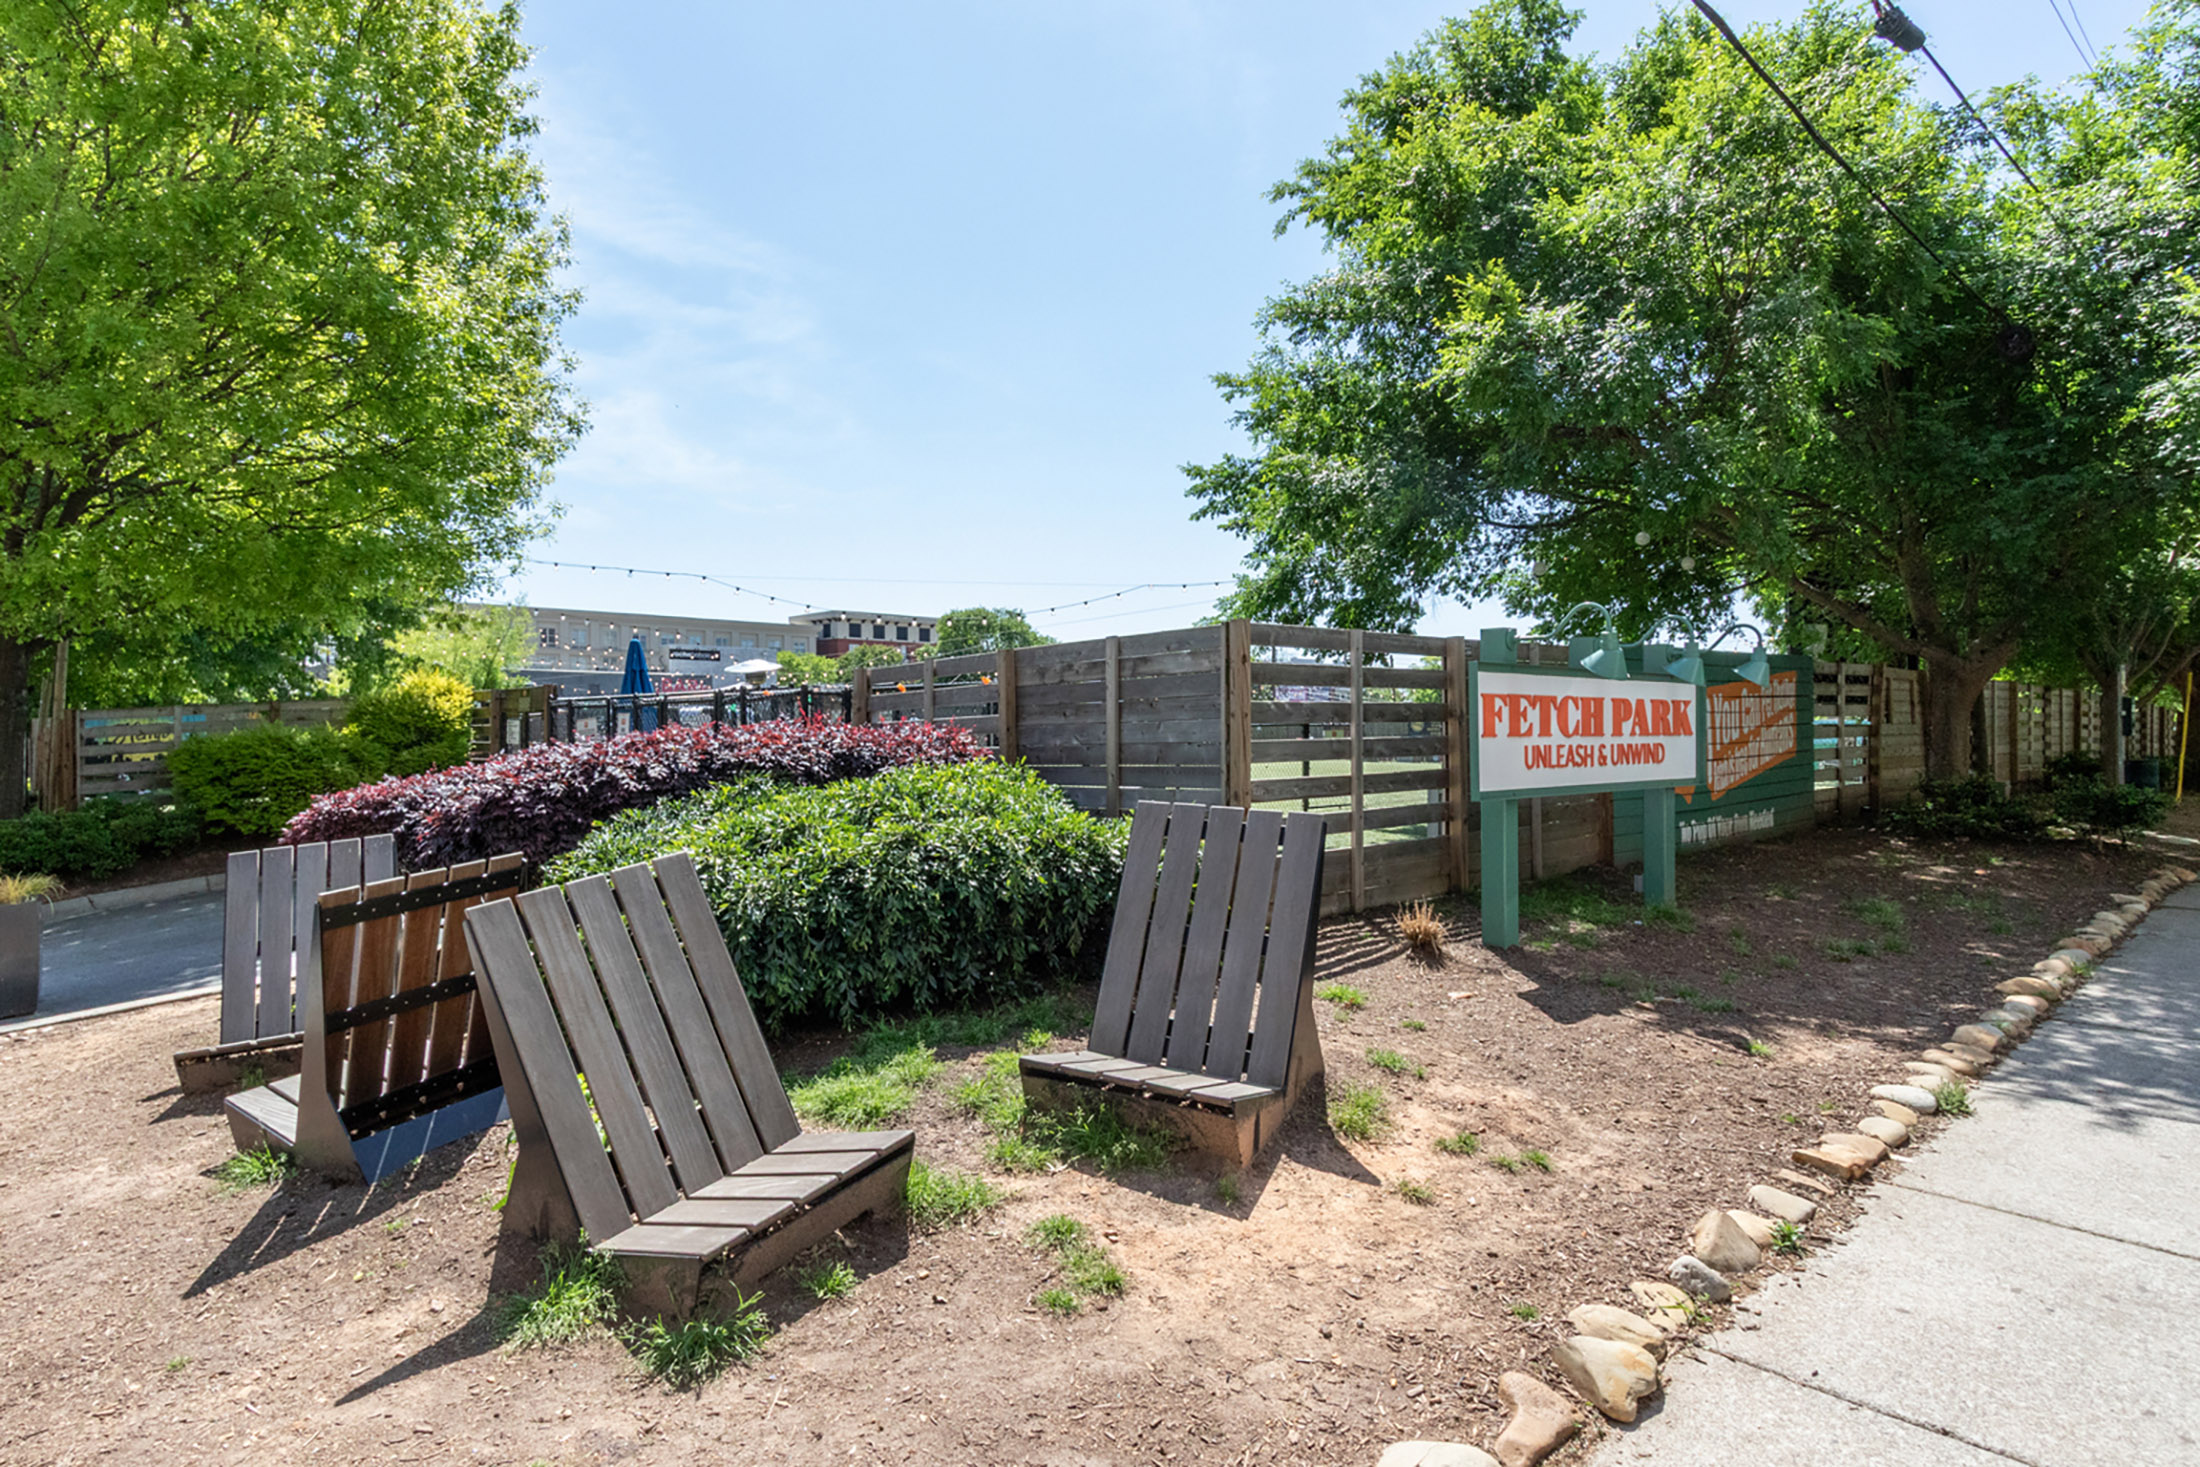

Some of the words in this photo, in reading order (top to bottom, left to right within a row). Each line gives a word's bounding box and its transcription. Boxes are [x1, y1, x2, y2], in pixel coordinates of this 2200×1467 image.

[1480, 693, 1605, 738] FETCH
[1610, 697, 1693, 737] PARK
[1712, 692, 1739, 751] You
[1524, 744, 1594, 770] UNLEASH
[1597, 743, 1607, 766] &
[1610, 743, 1666, 765] UNWIND
